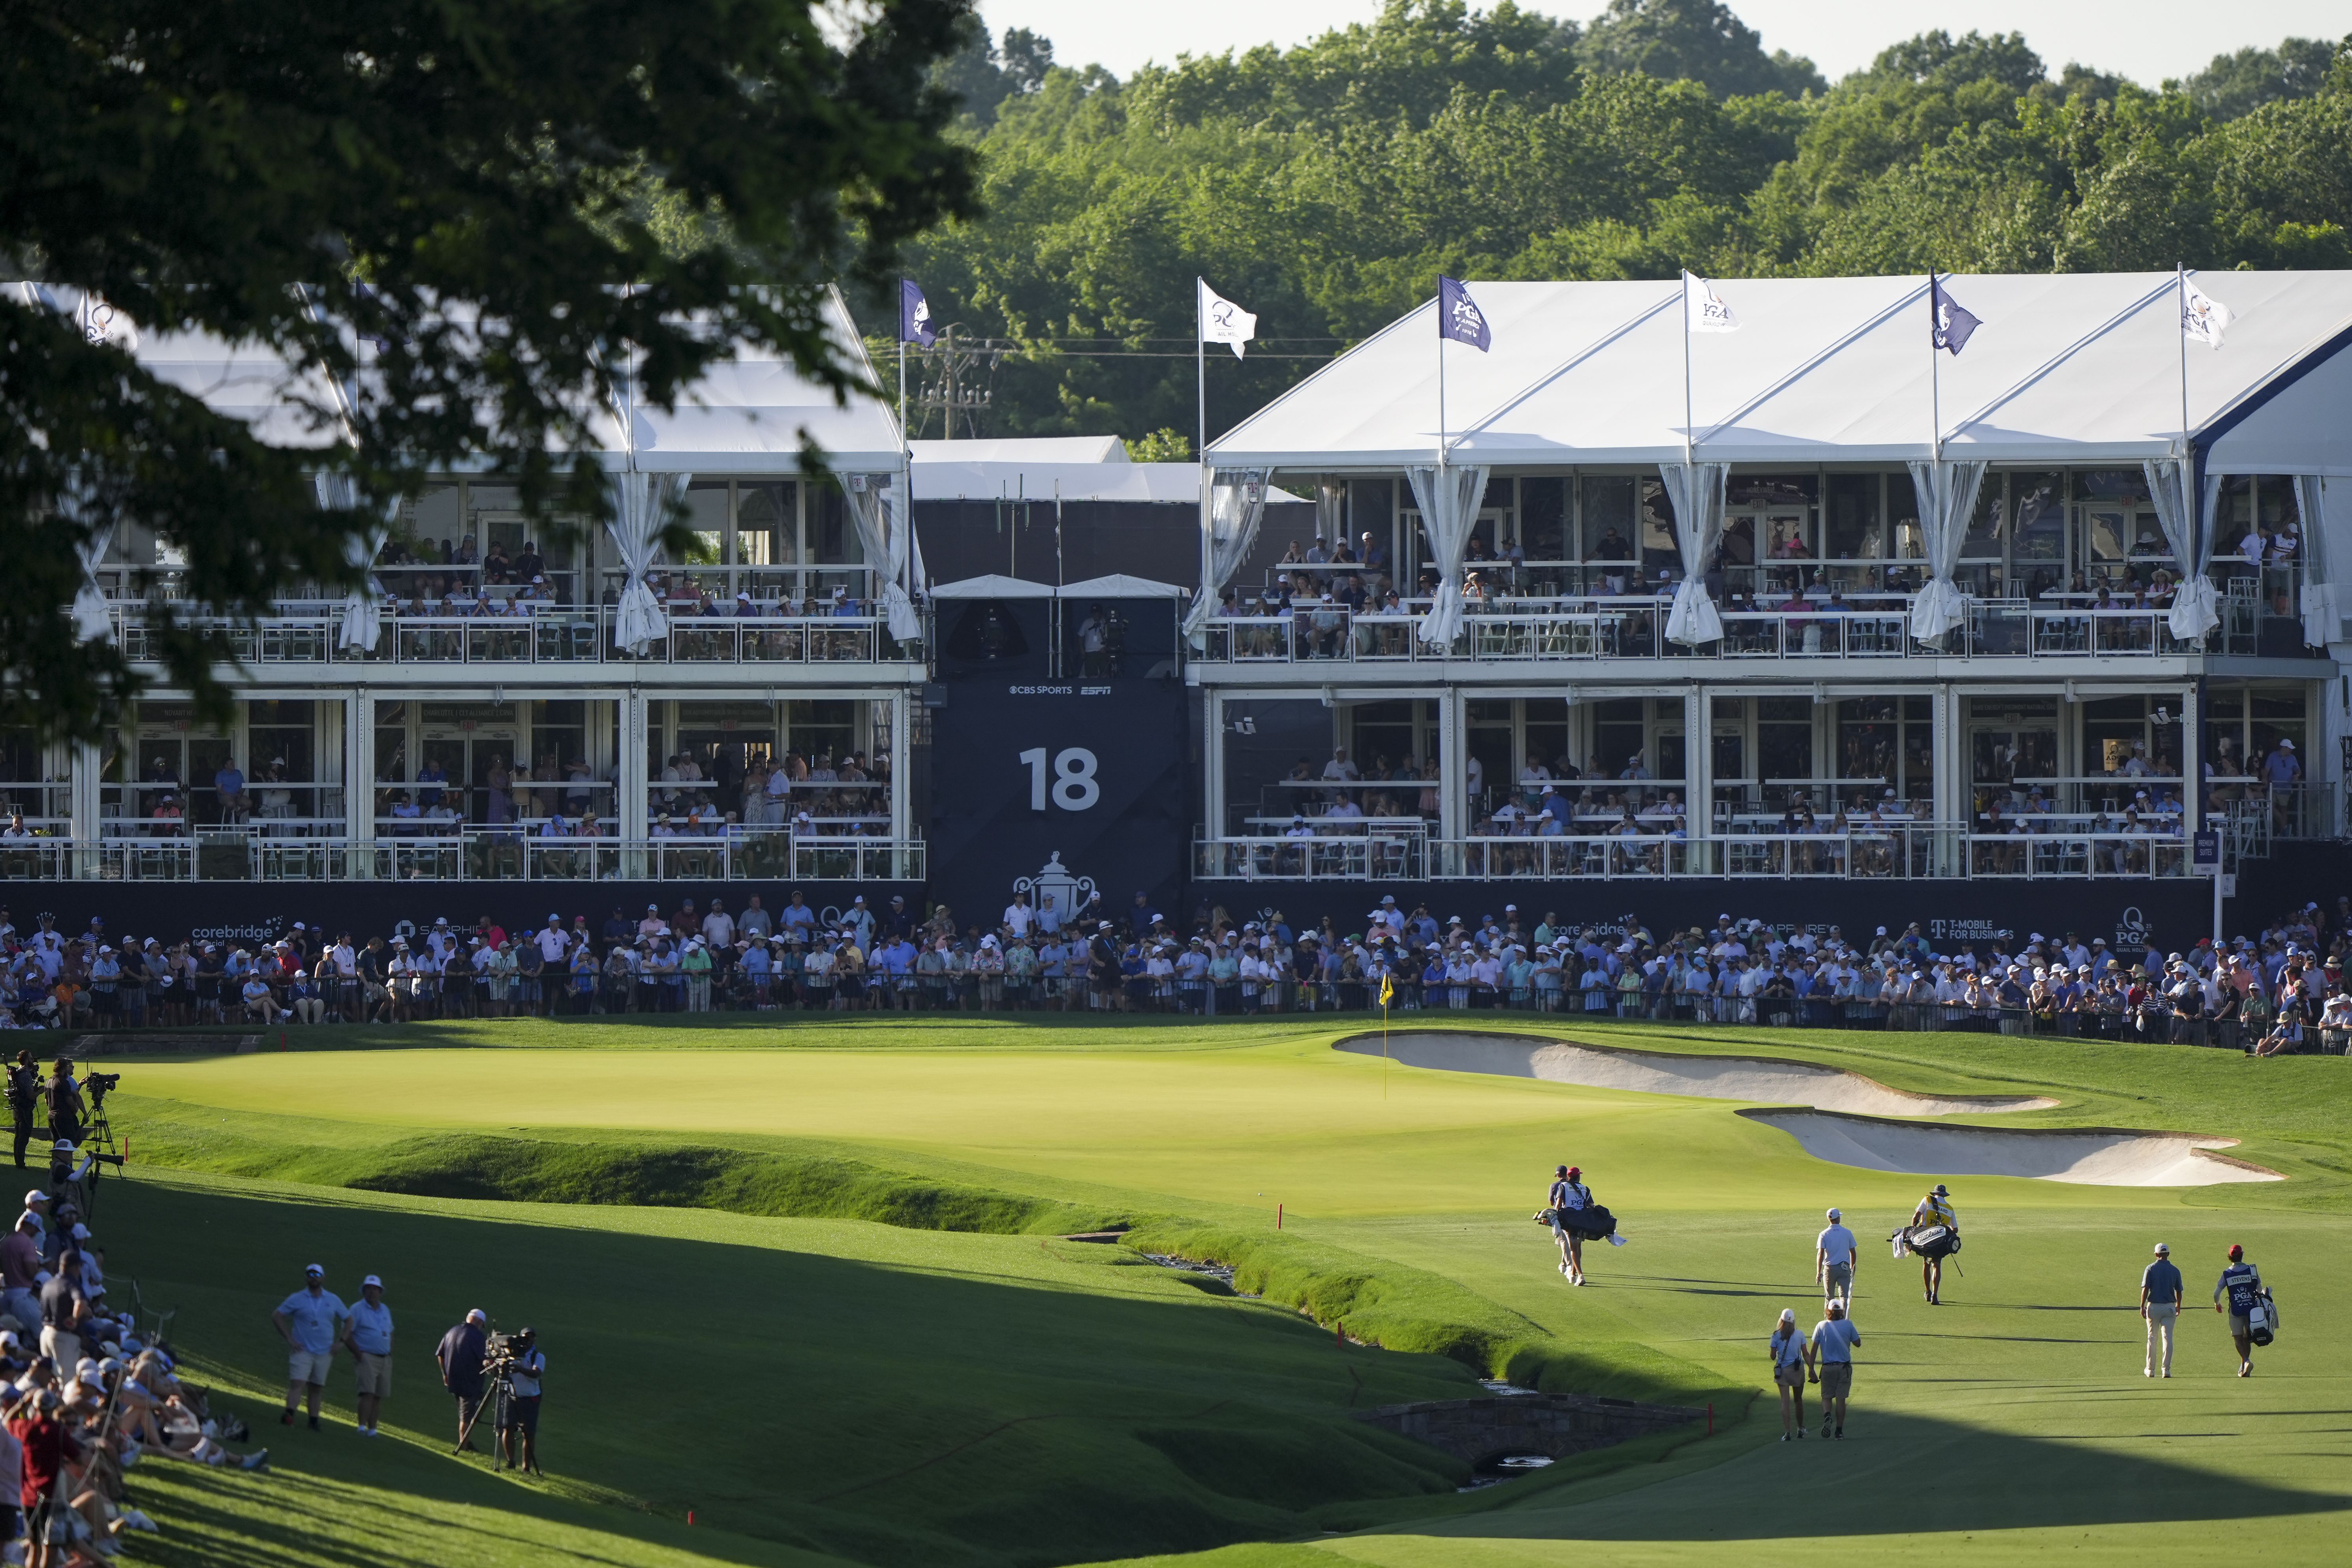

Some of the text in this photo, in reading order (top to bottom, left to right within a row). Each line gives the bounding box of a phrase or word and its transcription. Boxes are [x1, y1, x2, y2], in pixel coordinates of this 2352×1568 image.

[1452, 301, 1482, 324] PGA
[2183, 306, 2210, 334] PGA
[2181, 323, 2194, 332] QUAIL
[1753, 500, 1764, 509] EXIT
[2121, 497, 2133, 506] EXIT
[1018, 686, 1111, 695] CBS SPORTS ESPN
[2007, 714, 2019, 723] EXIT
[463, 721, 474, 730] EXIT
[1020, 747, 1100, 811] 18
[1553, 922, 1625, 936] coreidge
[1950, 920, 1992, 929] T-MOBILE
[192, 925, 272, 942] corebridge
[1950, 930, 2014, 939] FOR BUSINS
[1933, 1205, 1948, 1213] GRARD
[1918, 1228, 1943, 1244] Titleist
[2234, 1292, 2252, 1301] PGA
